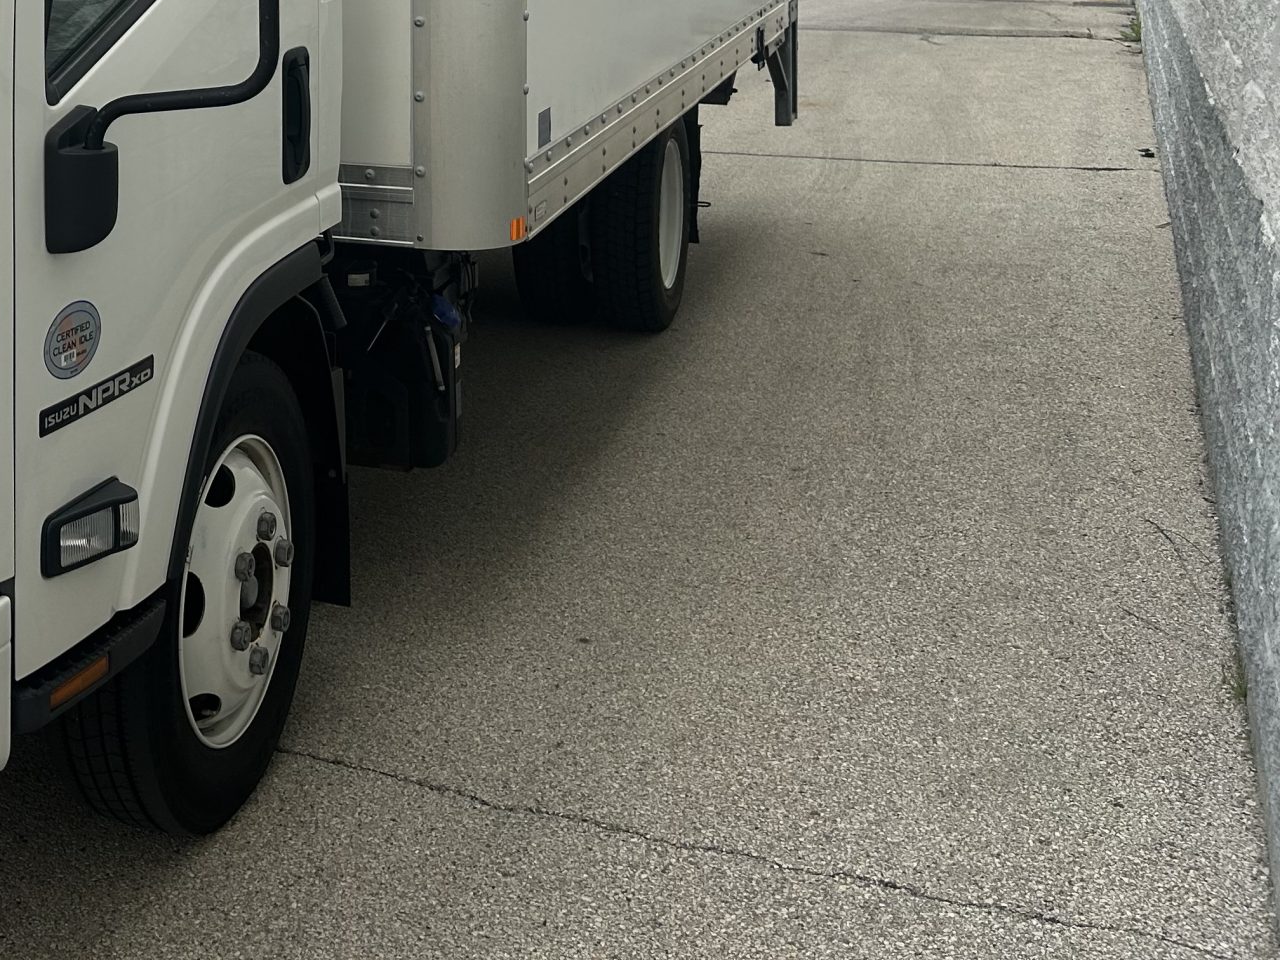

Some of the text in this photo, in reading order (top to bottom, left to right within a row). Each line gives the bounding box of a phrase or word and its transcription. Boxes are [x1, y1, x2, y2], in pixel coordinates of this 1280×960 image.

[53, 339, 77, 357] CLEAN
[78, 330, 94, 345] IDLE
[56, 320, 90, 343] CERTIFIED
[44, 403, 77, 429] ISUZU
